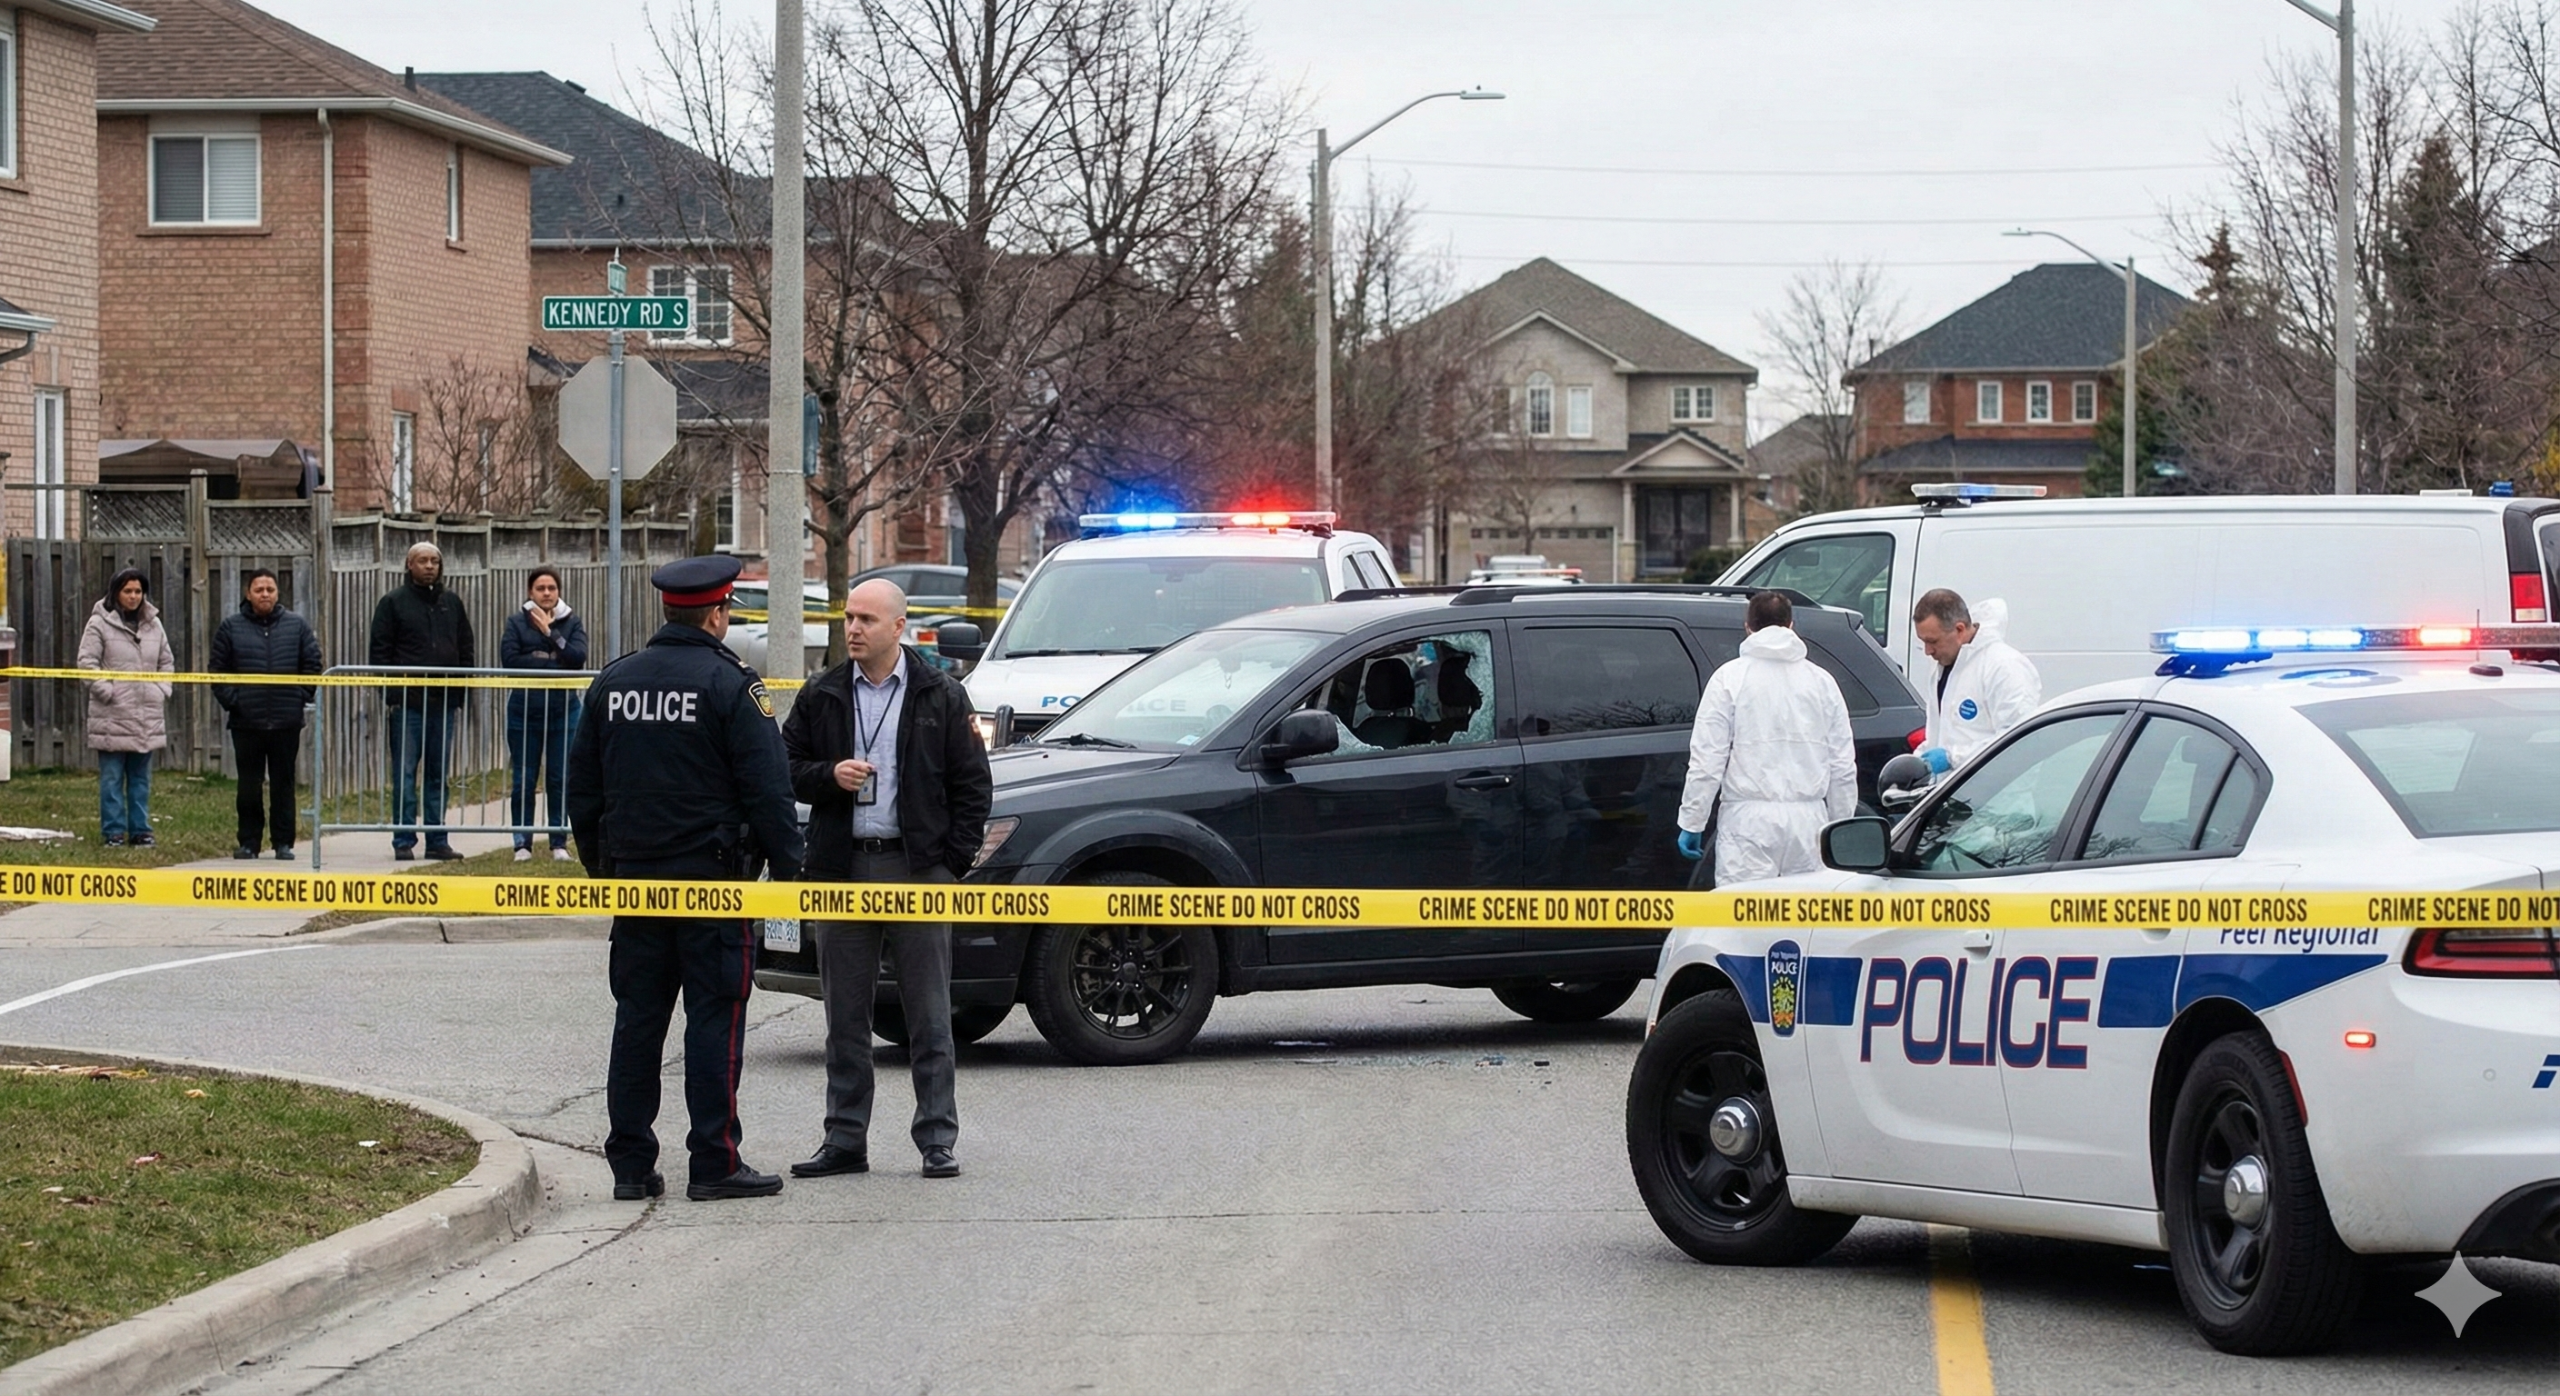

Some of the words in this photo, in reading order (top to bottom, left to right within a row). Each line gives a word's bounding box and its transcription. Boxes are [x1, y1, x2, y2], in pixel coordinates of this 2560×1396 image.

[549, 302, 631, 325] KENNEDY
[640, 302, 663, 325] RD
[672, 302, 684, 326] S
[608, 690, 698, 723] POLICE
[13, 872, 36, 895] DO
[42, 873, 75, 896] NOT
[80, 874, 137, 898] CROSS
[193, 877, 247, 900] CRIME
[253, 879, 307, 902] SCENE
[313, 880, 336, 903] DO
[342, 881, 376, 904] NOT
[383, 882, 438, 905] CROSS
[495, 884, 549, 907] CRIME
[556, 885, 610, 908] SCENE
[617, 886, 640, 909] DO
[646, 887, 679, 910] NOT
[686, 887, 742, 911] CROSS
[799, 890, 854, 913] CRIME
[861, 891, 916, 914] SCENE
[923, 892, 946, 915] DO
[952, 892, 986, 915] NOT
[992, 892, 1049, 916] CROSS
[1108, 894, 1163, 917] CRIME
[1170, 894, 1225, 917] SCENE
[1232, 895, 1256, 918] DO
[1262, 895, 1296, 918] NOT
[1302, 896, 1360, 919] CROSS
[1420, 897, 1476, 920] CRIME
[1482, 897, 1538, 920] SCENE
[1545, 898, 1569, 921] DO
[1575, 898, 1609, 921] NOT
[1615, 898, 1673, 921] CROSS
[1734, 899, 1790, 922] CRIME
[1797, 899, 1853, 922] SCENE
[1860, 899, 1884, 922] DO
[1890, 899, 1925, 922] NOT
[1931, 899, 1990, 922] CROSS
[2051, 899, 2107, 922] CRIME
[2114, 899, 2170, 922] SCENE
[2177, 899, 2201, 922] DO
[2207, 899, 2243, 922] NOT
[2249, 898, 2308, 922] CROSS
[2368, 898, 2426, 921] CRIME
[2433, 897, 2490, 921] SCENE
[2497, 897, 2521, 921] DO
[2528, 897, 2560, 921] NOT
[1860, 956, 2099, 1069] POLICE
